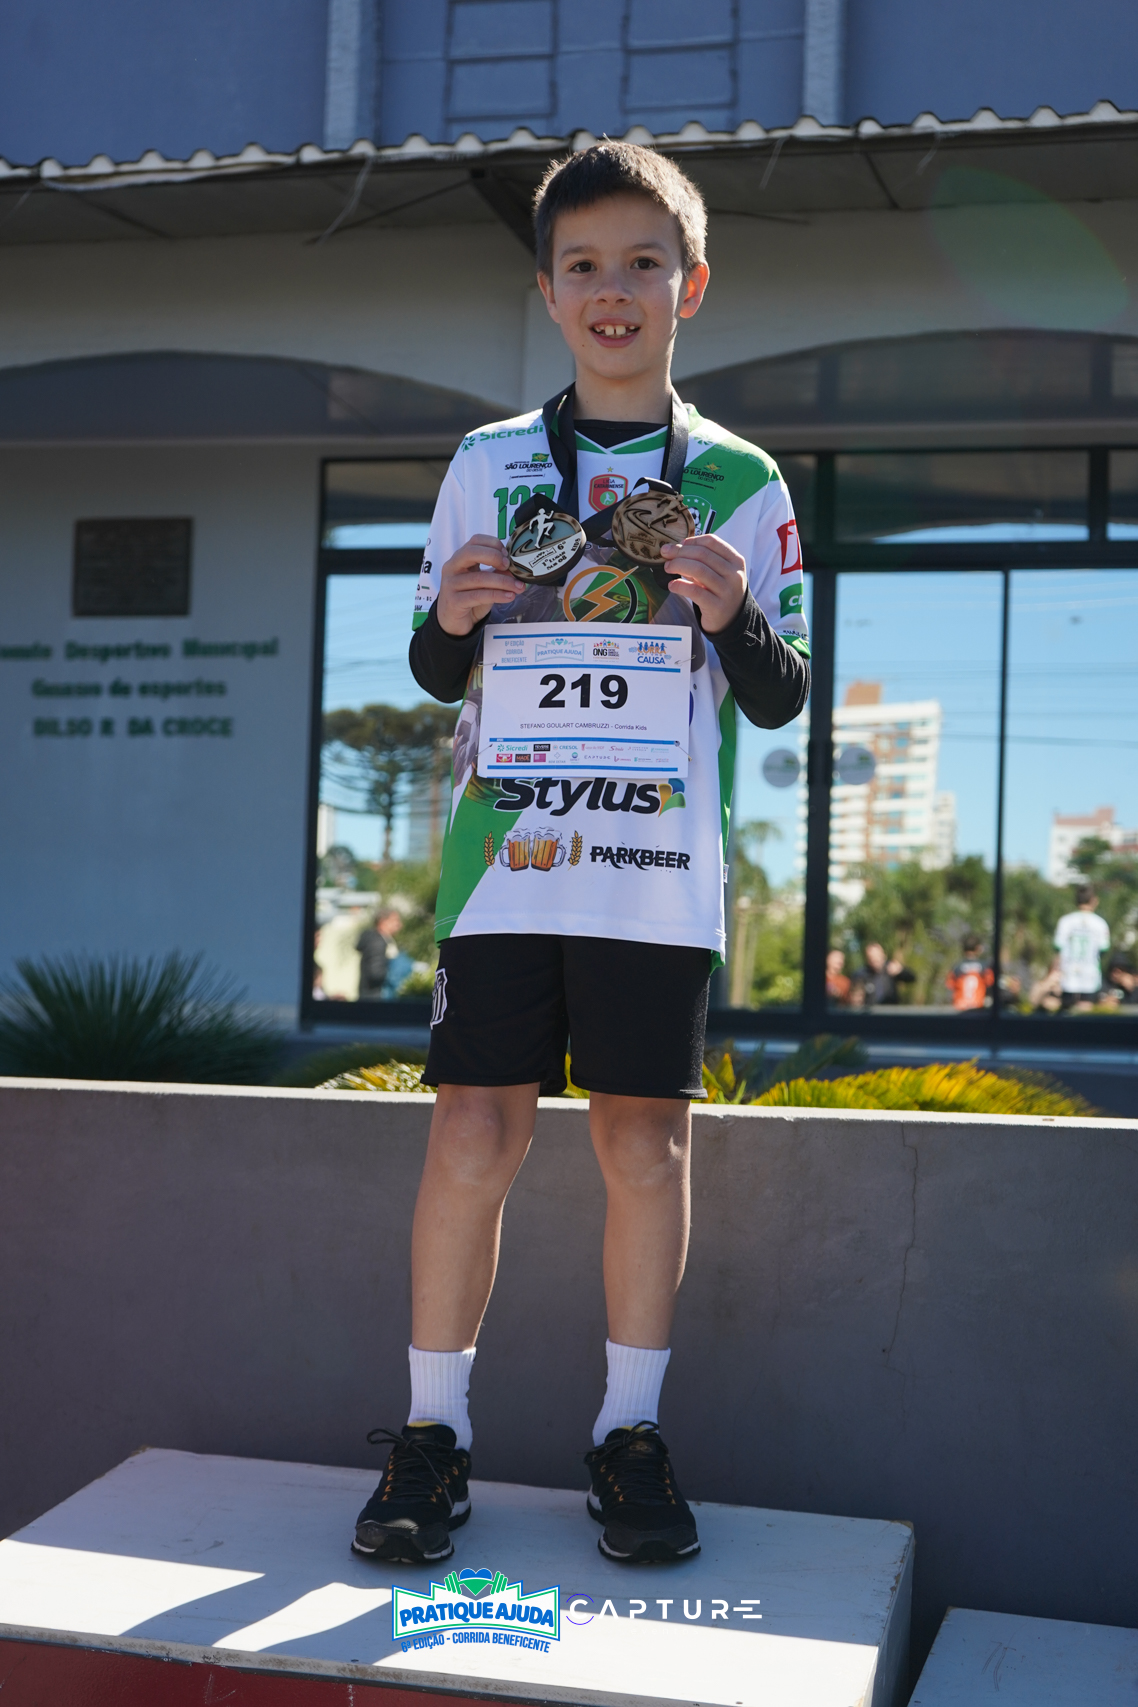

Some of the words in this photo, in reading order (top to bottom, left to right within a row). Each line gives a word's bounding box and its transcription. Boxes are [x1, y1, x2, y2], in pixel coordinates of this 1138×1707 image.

[480, 424, 543, 441] Sicredi
[690, 469, 724, 481] LOURENÇO
[593, 648, 607, 656] ONG
[637, 656, 665, 664] CAUSA
[109, 677, 133, 697] de
[137, 679, 227, 701] esportes
[538, 673, 629, 710] 219
[494, 777, 661, 816] Stylus
[590, 845, 690, 870] PARKBEER
